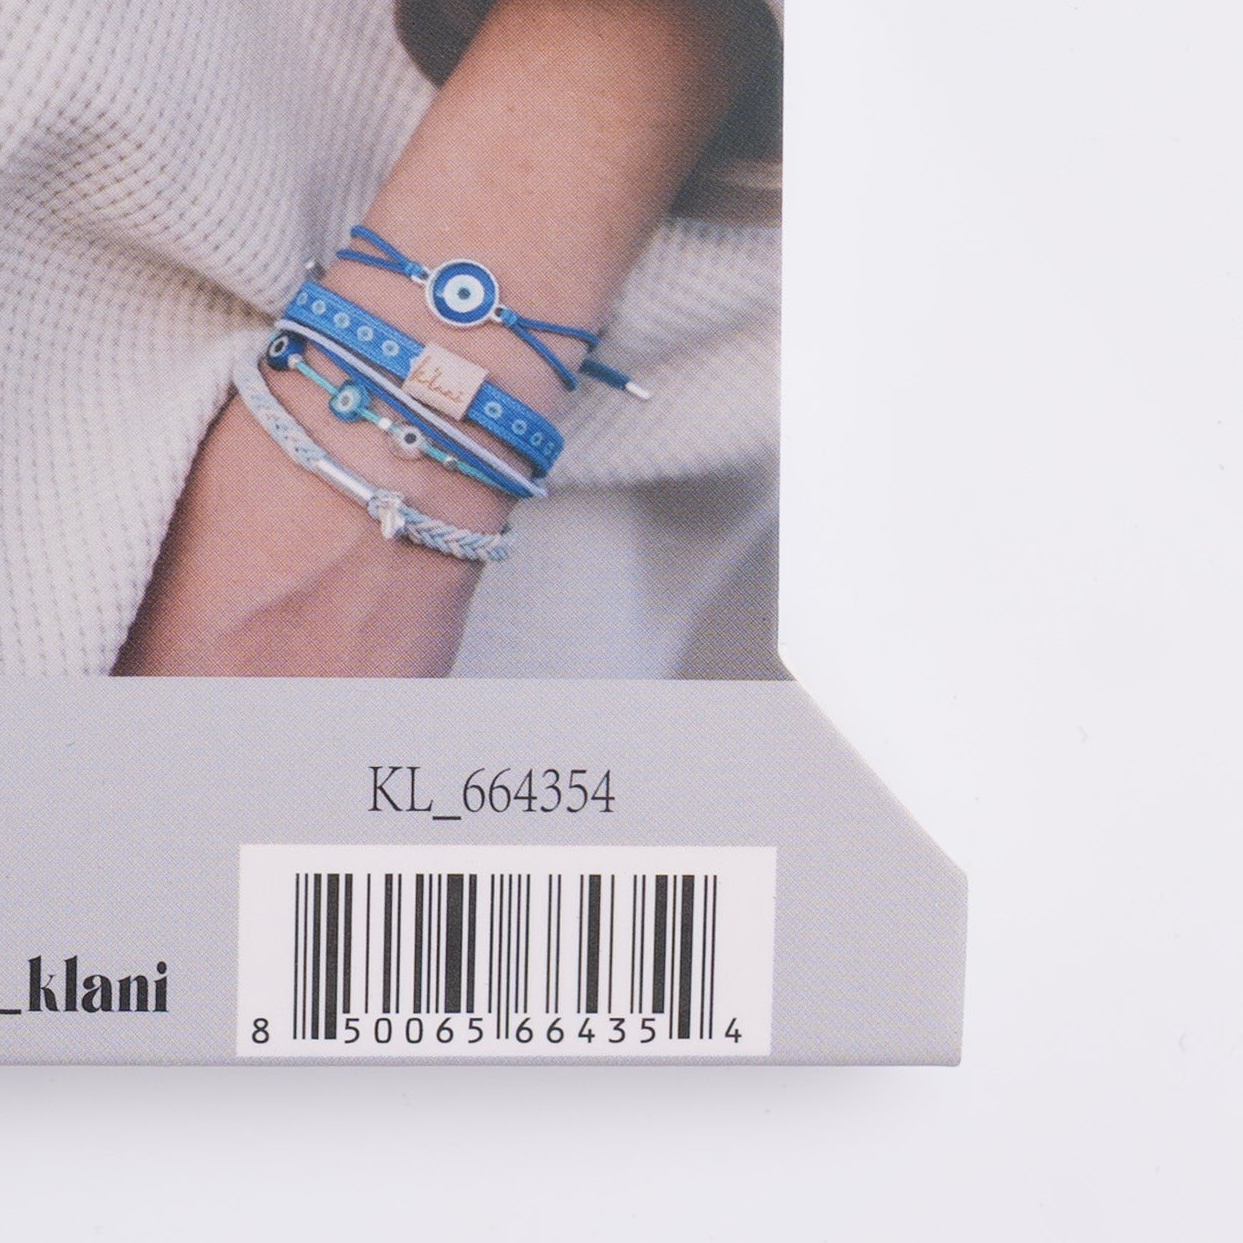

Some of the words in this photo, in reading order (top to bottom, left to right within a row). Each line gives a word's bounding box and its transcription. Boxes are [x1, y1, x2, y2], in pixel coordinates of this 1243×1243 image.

[367, 765, 616, 821] KL_664354
[251, 1017, 270, 1045] 8
[724, 1017, 742, 1045] 4
